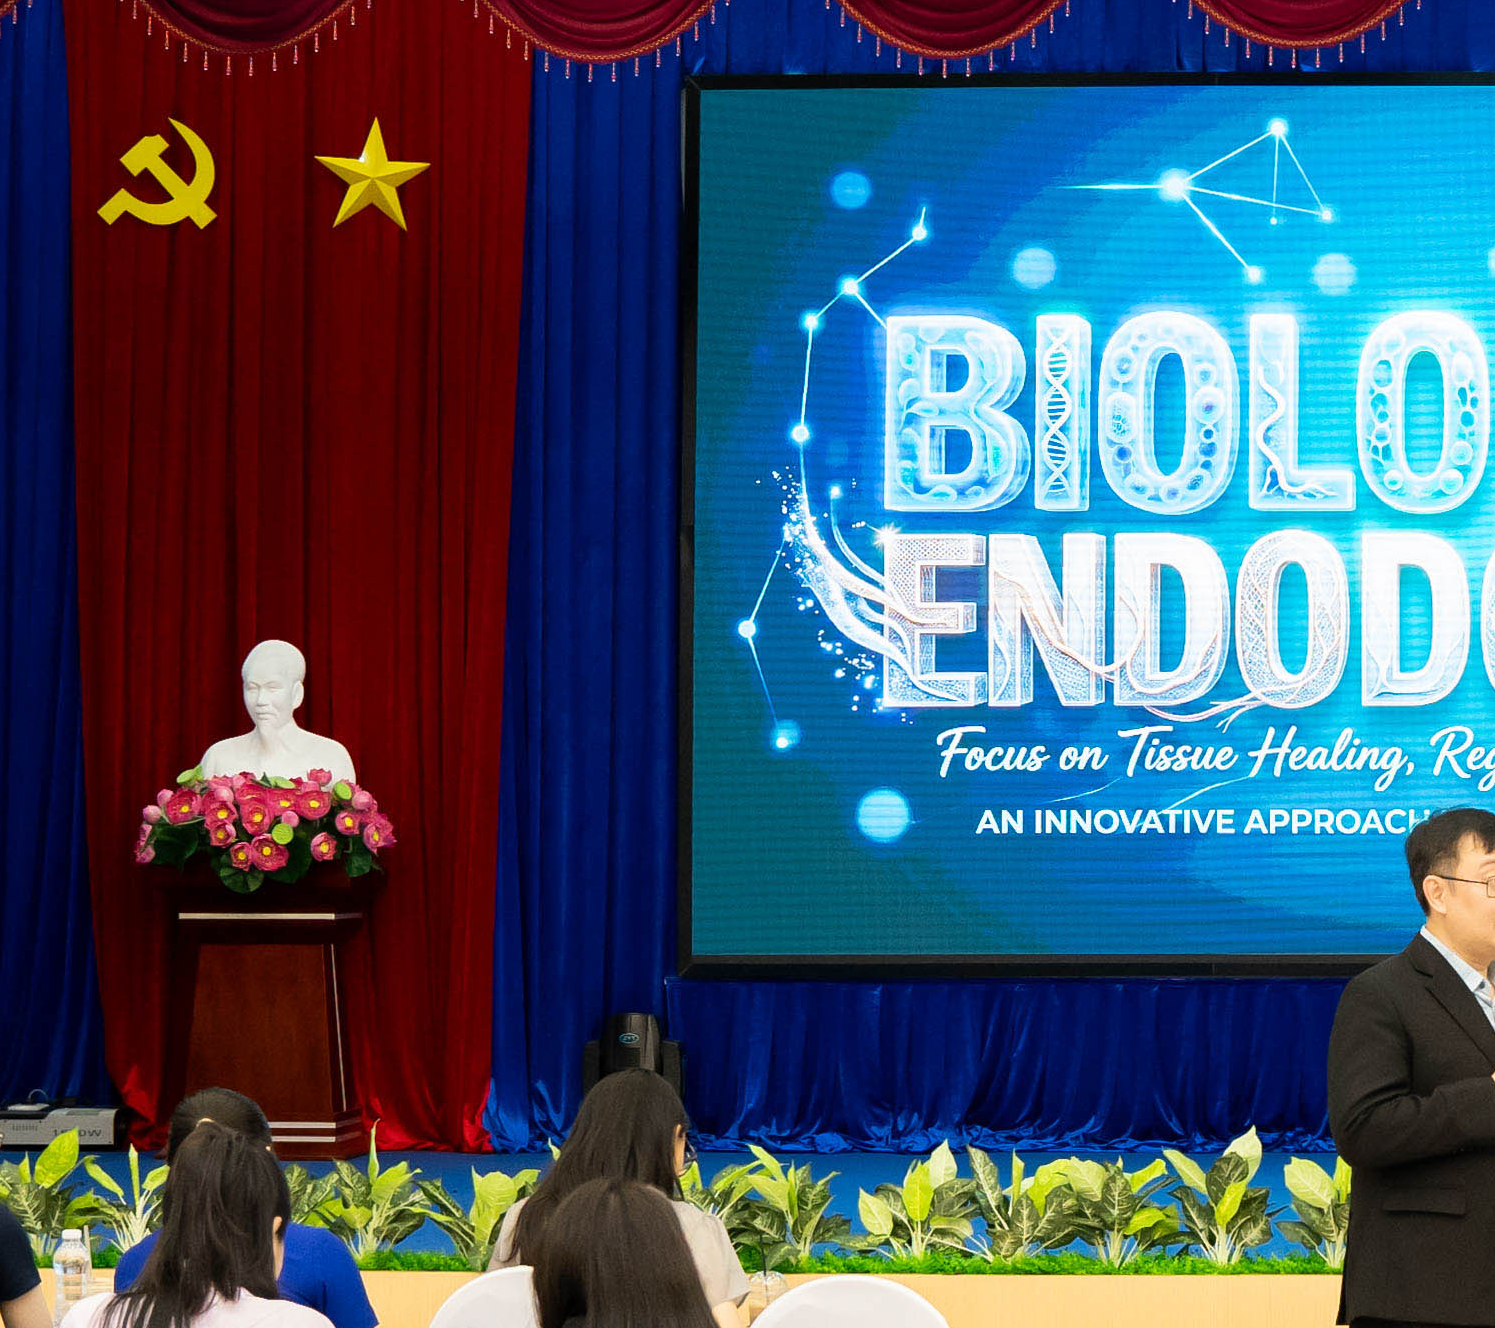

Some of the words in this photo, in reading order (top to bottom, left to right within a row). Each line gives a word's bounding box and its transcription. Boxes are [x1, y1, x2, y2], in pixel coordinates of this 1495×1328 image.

[936, 726, 1050, 778] Focus
[1059, 745, 1108, 771] on
[1117, 725, 1239, 777] Tissue
[1248, 725, 1413, 792] Healing,
[976, 809, 1024, 835] AN
[1035, 809, 1235, 835] INNOVATIVE
